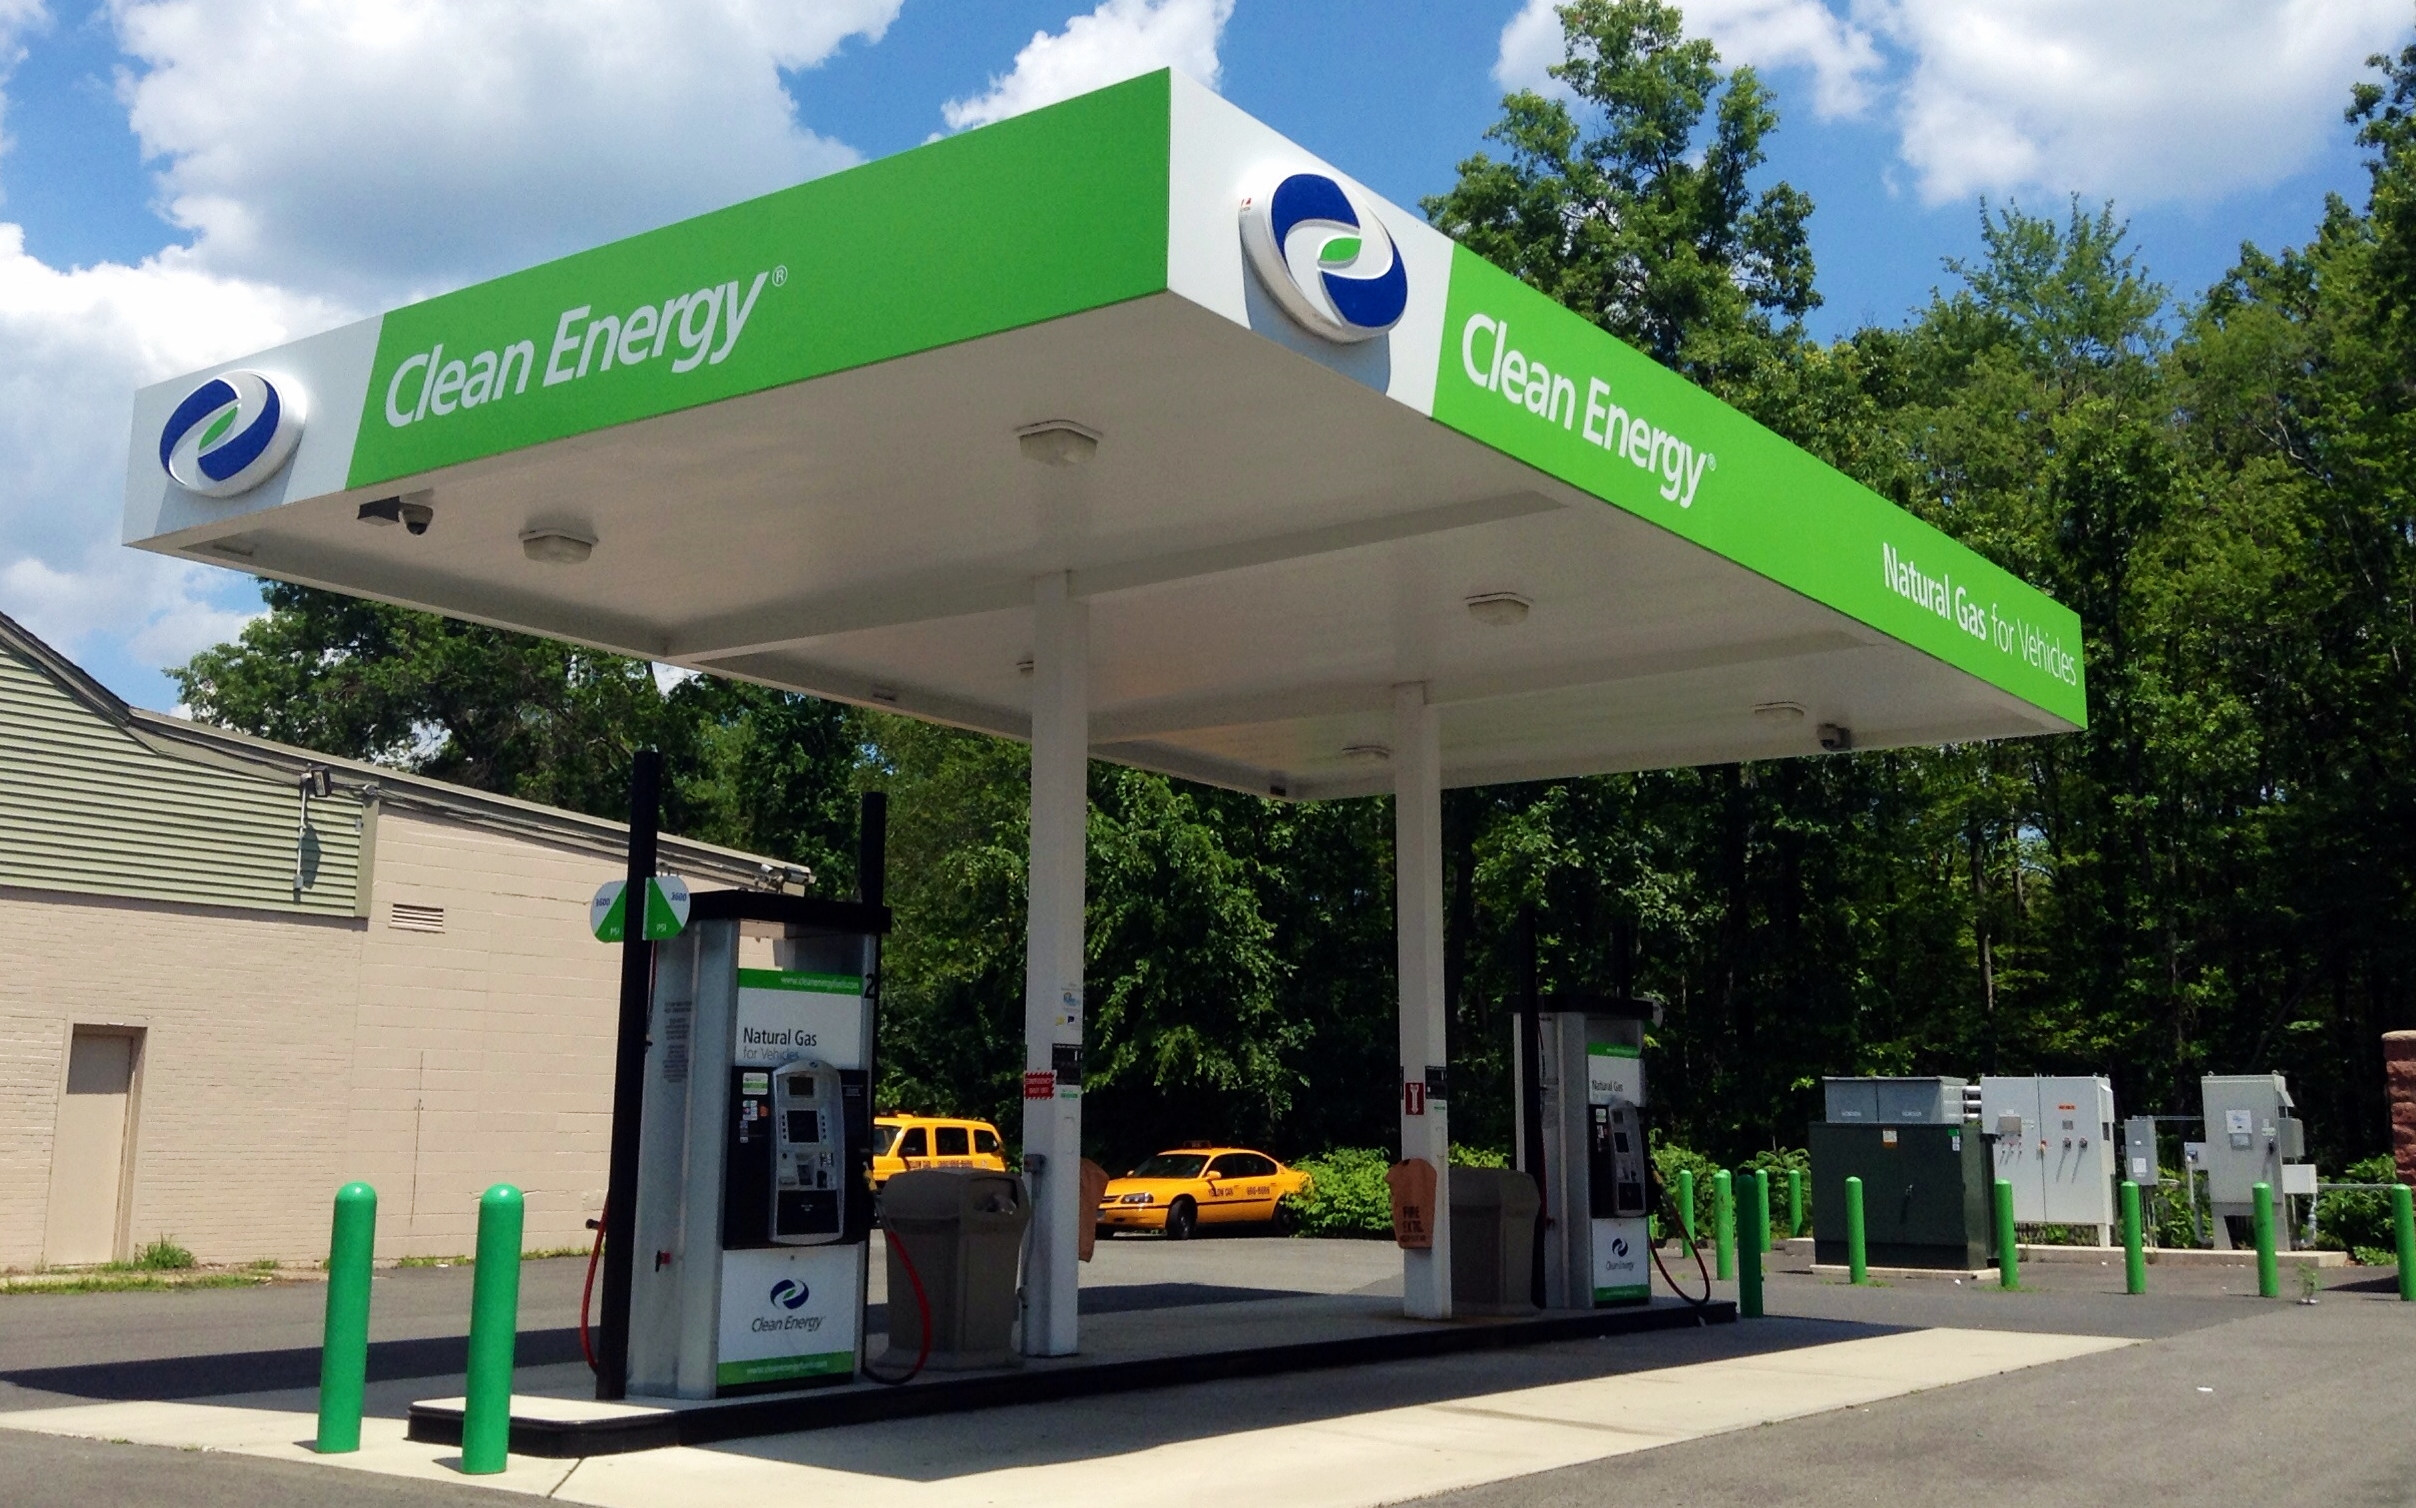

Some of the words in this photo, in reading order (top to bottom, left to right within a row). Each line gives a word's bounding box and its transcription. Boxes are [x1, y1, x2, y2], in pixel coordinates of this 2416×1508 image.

[385, 338, 535, 428] Clean
[1462, 313, 1576, 431] Clean
[1883, 542, 1951, 620] Natural
[1955, 586, 1987, 641] Gas
[1991, 603, 2014, 655] for
[2017, 618, 2076, 686] Vehicles
[864, 973, 875, 998] 2
[743, 1027, 791, 1045] Natural
[795, 1030, 817, 1047] Gas
[743, 1046, 757, 1060] for
[751, 1316, 783, 1332] Clean
[784, 1315, 824, 1332] Energy
